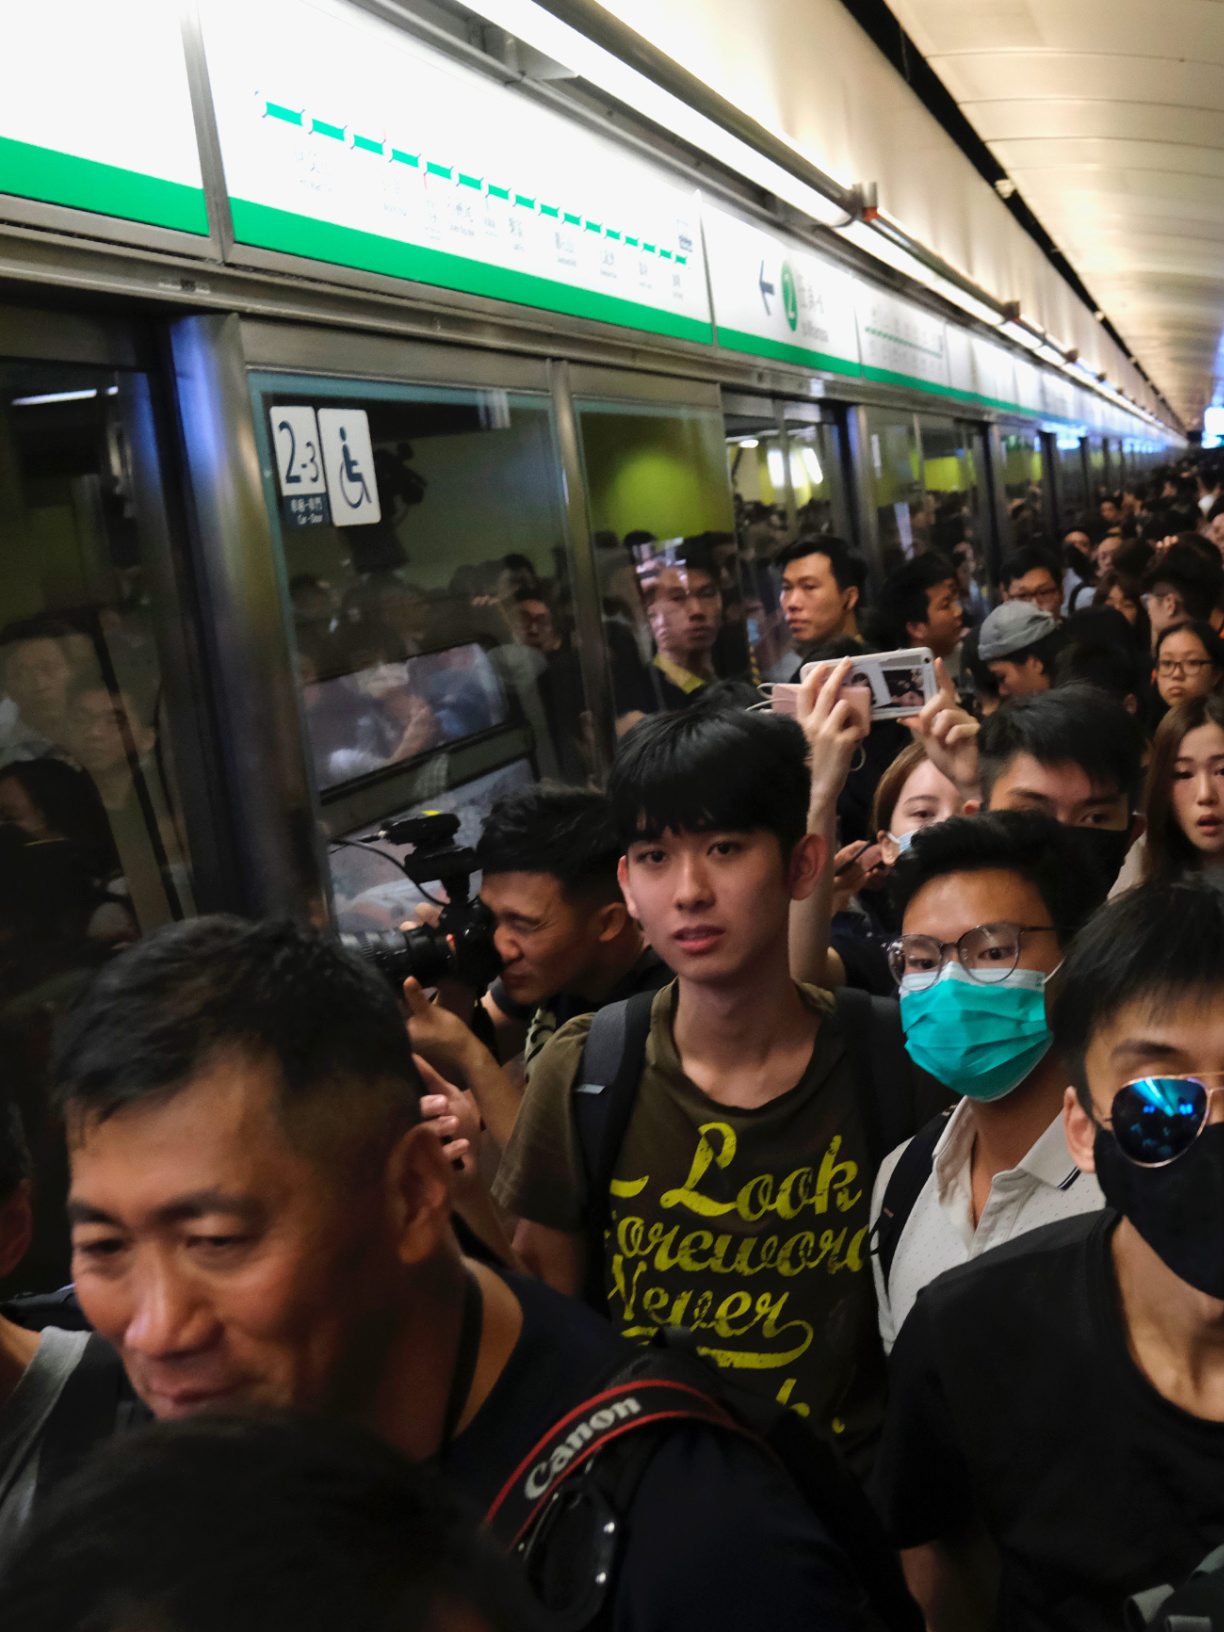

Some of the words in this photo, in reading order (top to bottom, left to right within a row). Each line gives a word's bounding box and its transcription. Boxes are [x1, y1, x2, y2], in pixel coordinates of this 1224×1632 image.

[279, 421, 319, 483] 2-3
[660, 1121, 862, 1221] Look
[604, 1214, 869, 1277] orewor
[607, 1253, 813, 1367] Never
[525, 1397, 642, 1500] Canon
